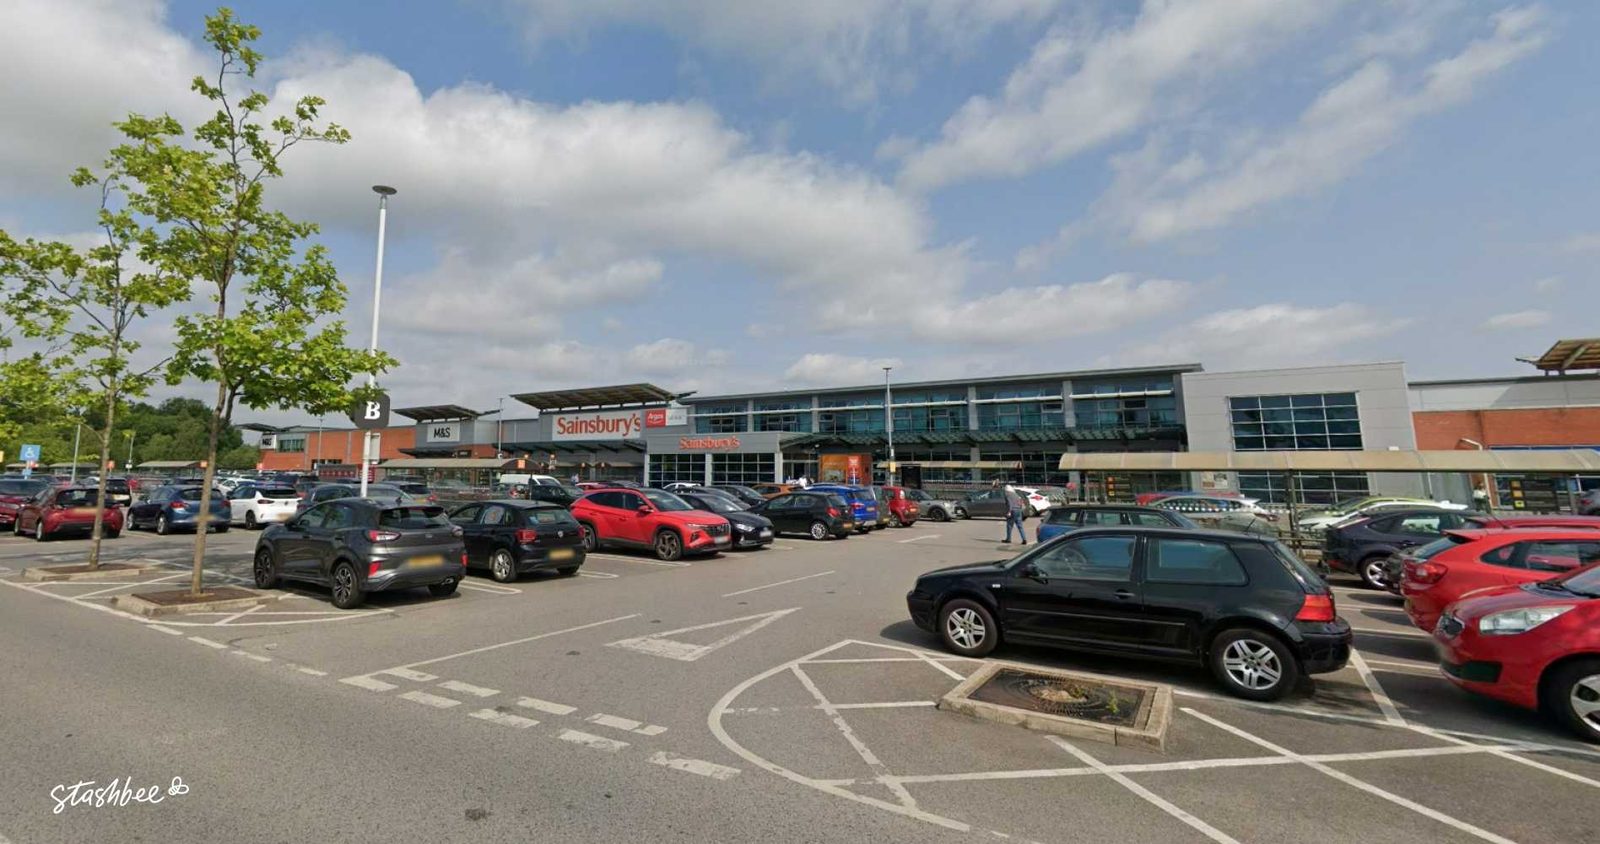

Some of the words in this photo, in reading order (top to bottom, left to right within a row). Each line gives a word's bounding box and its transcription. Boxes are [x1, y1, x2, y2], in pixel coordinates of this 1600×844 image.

[364, 401, 381, 420] B
[433, 427, 451, 438] M&S
[557, 413, 641, 437] Sainsbury's
[679, 436, 740, 452] Sainsbury's
